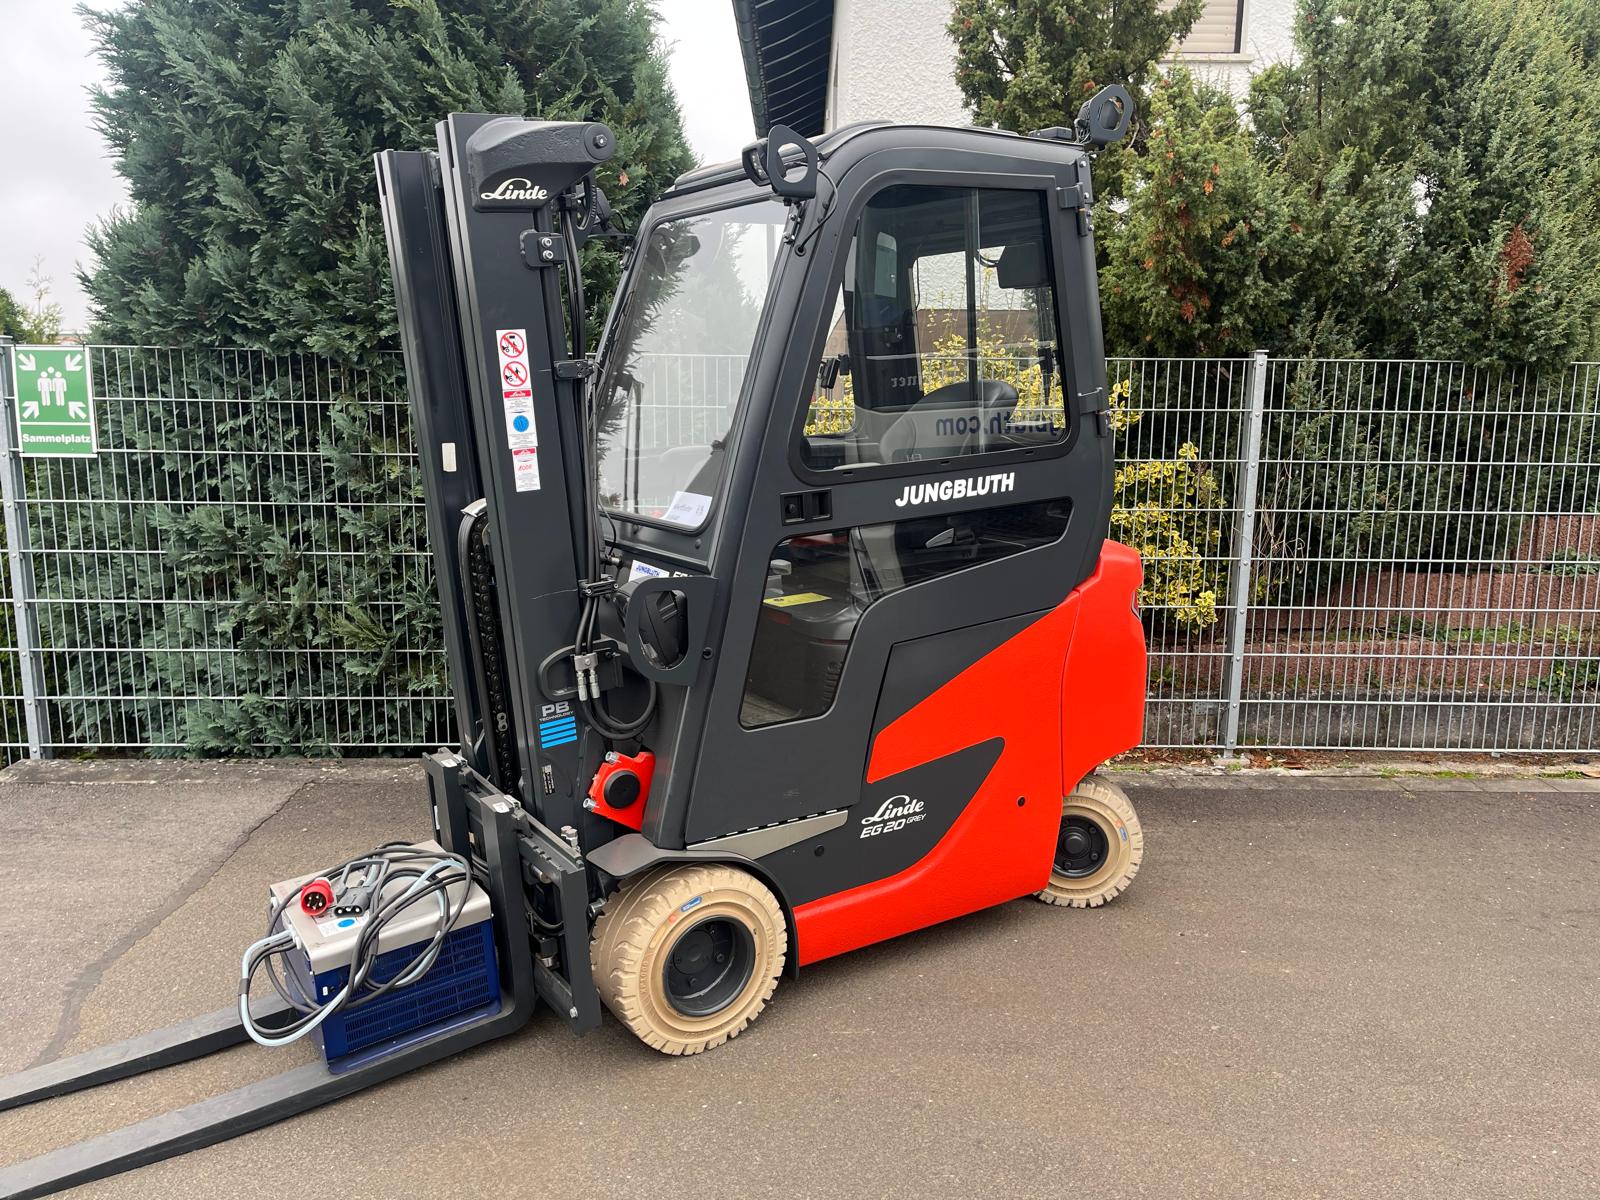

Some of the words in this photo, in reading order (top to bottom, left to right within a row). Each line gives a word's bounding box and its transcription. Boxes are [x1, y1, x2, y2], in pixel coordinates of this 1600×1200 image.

[480, 177, 548, 200] Linde
[22, 433, 91, 445] Sammelplatz
[895, 472, 1015, 507] JUNGBLUTH
[541, 700, 570, 717] PB
[861, 794, 925, 825] Linde
[860, 823, 884, 839] EG
[883, 818, 907, 834] 20
[906, 813, 927, 824] GREY
